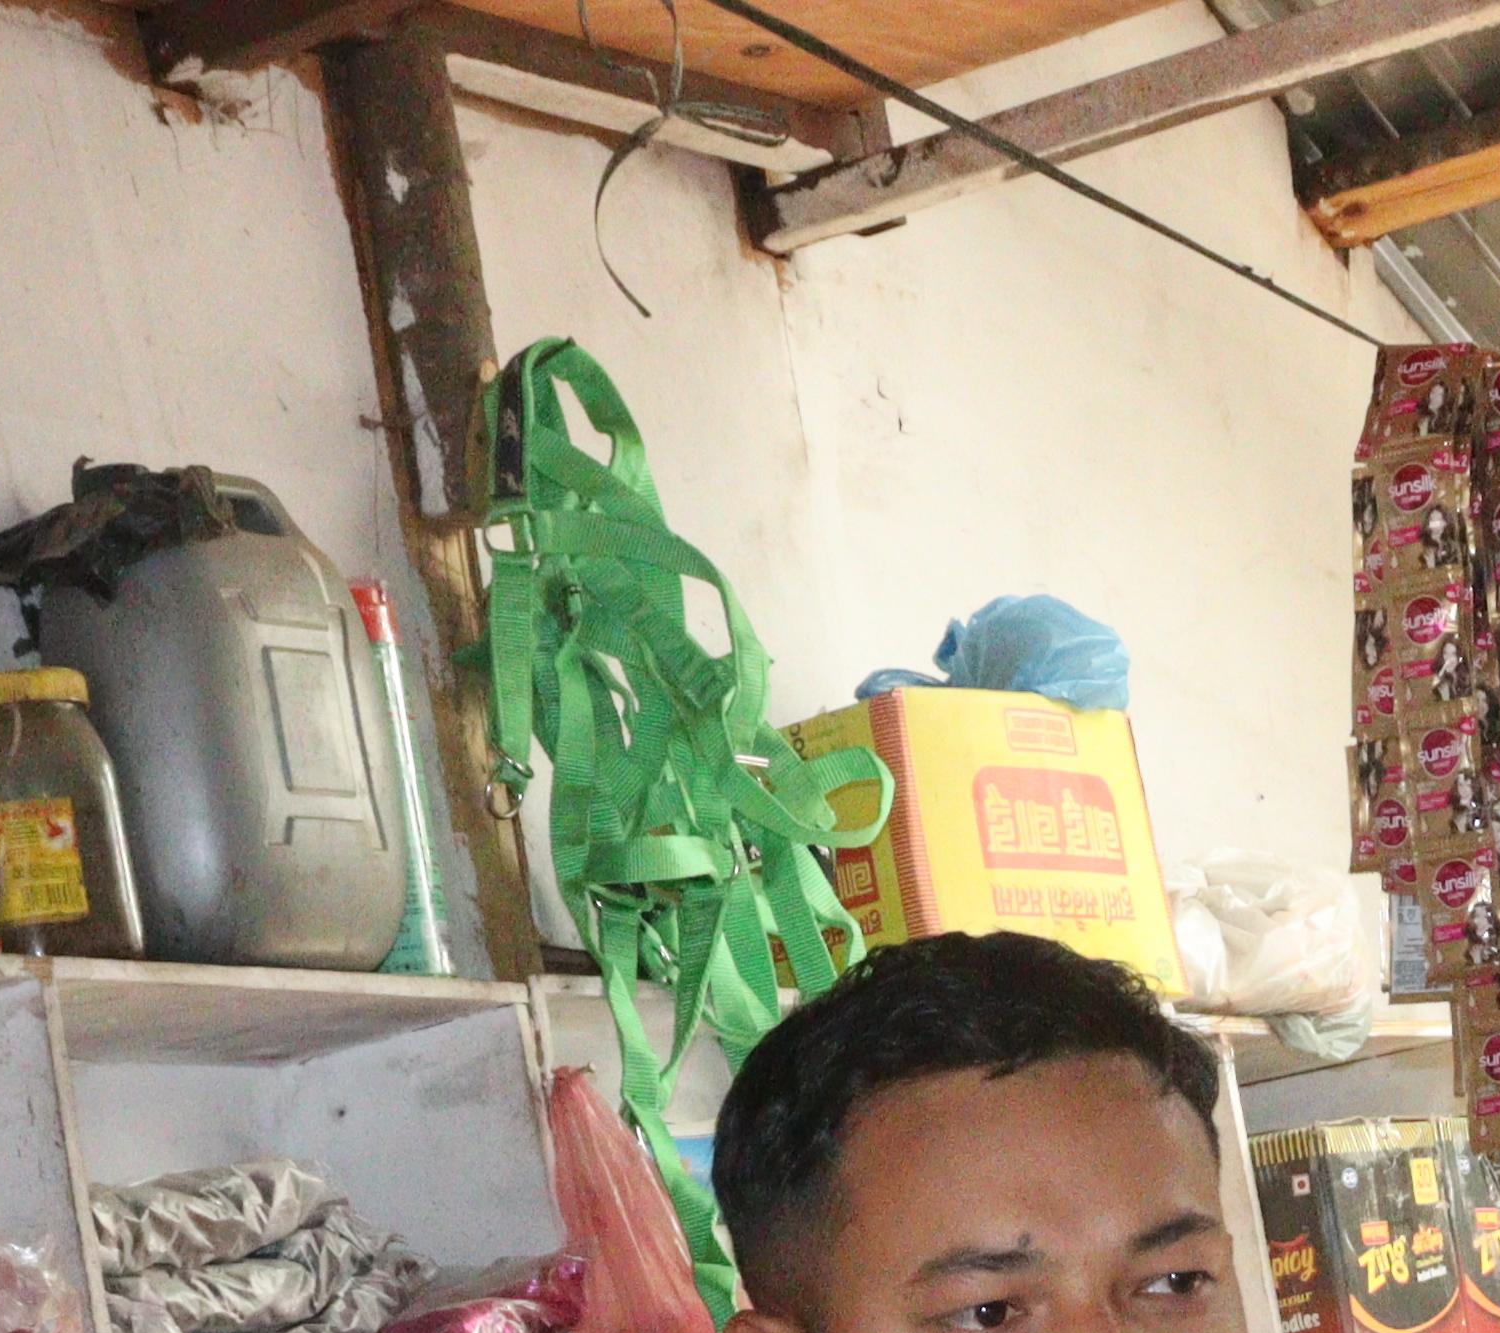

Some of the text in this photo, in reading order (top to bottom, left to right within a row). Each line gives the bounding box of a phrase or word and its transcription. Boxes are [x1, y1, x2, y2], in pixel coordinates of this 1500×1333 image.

[1398, 354, 1447, 375] sunsilk
[1389, 474, 1437, 499] sunsilk
[1417, 741, 1463, 764] sunsilk
[1430, 870, 1482, 896] sunsilk
[1270, 1246, 1318, 1289] picy
[1359, 1235, 1411, 1294] Zing
